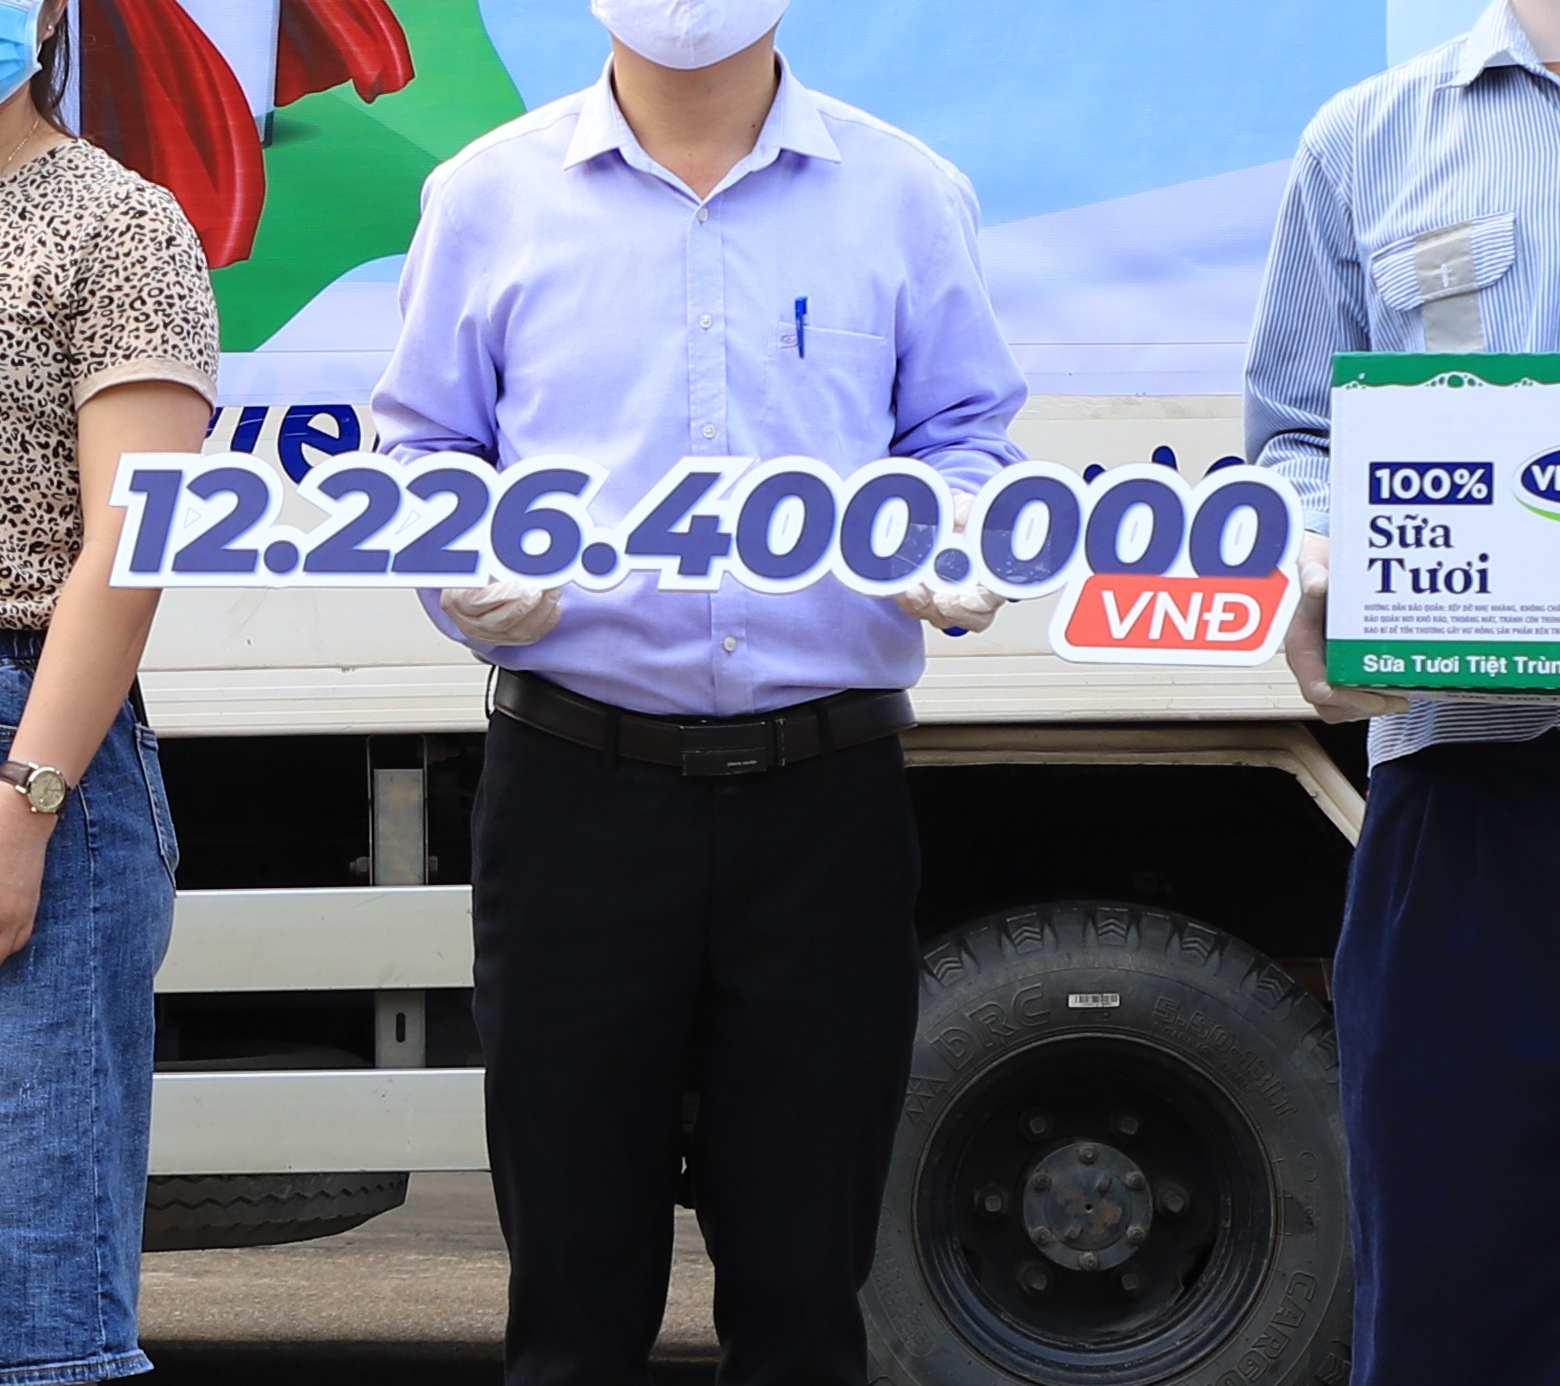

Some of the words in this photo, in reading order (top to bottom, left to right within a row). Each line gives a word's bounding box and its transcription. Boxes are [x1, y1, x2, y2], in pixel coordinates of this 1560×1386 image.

[1376, 469, 1487, 498] 100%
[130, 463, 1288, 581] 12.226.400.000
[1367, 512, 1455, 550] Sữa
[1367, 552, 1493, 596] Tươi
[1103, 591, 1260, 640] VNĐ
[1362, 654, 1406, 674] Sữa
[1411, 655, 1460, 673] Tươi
[1466, 655, 1508, 677] Tiệt
